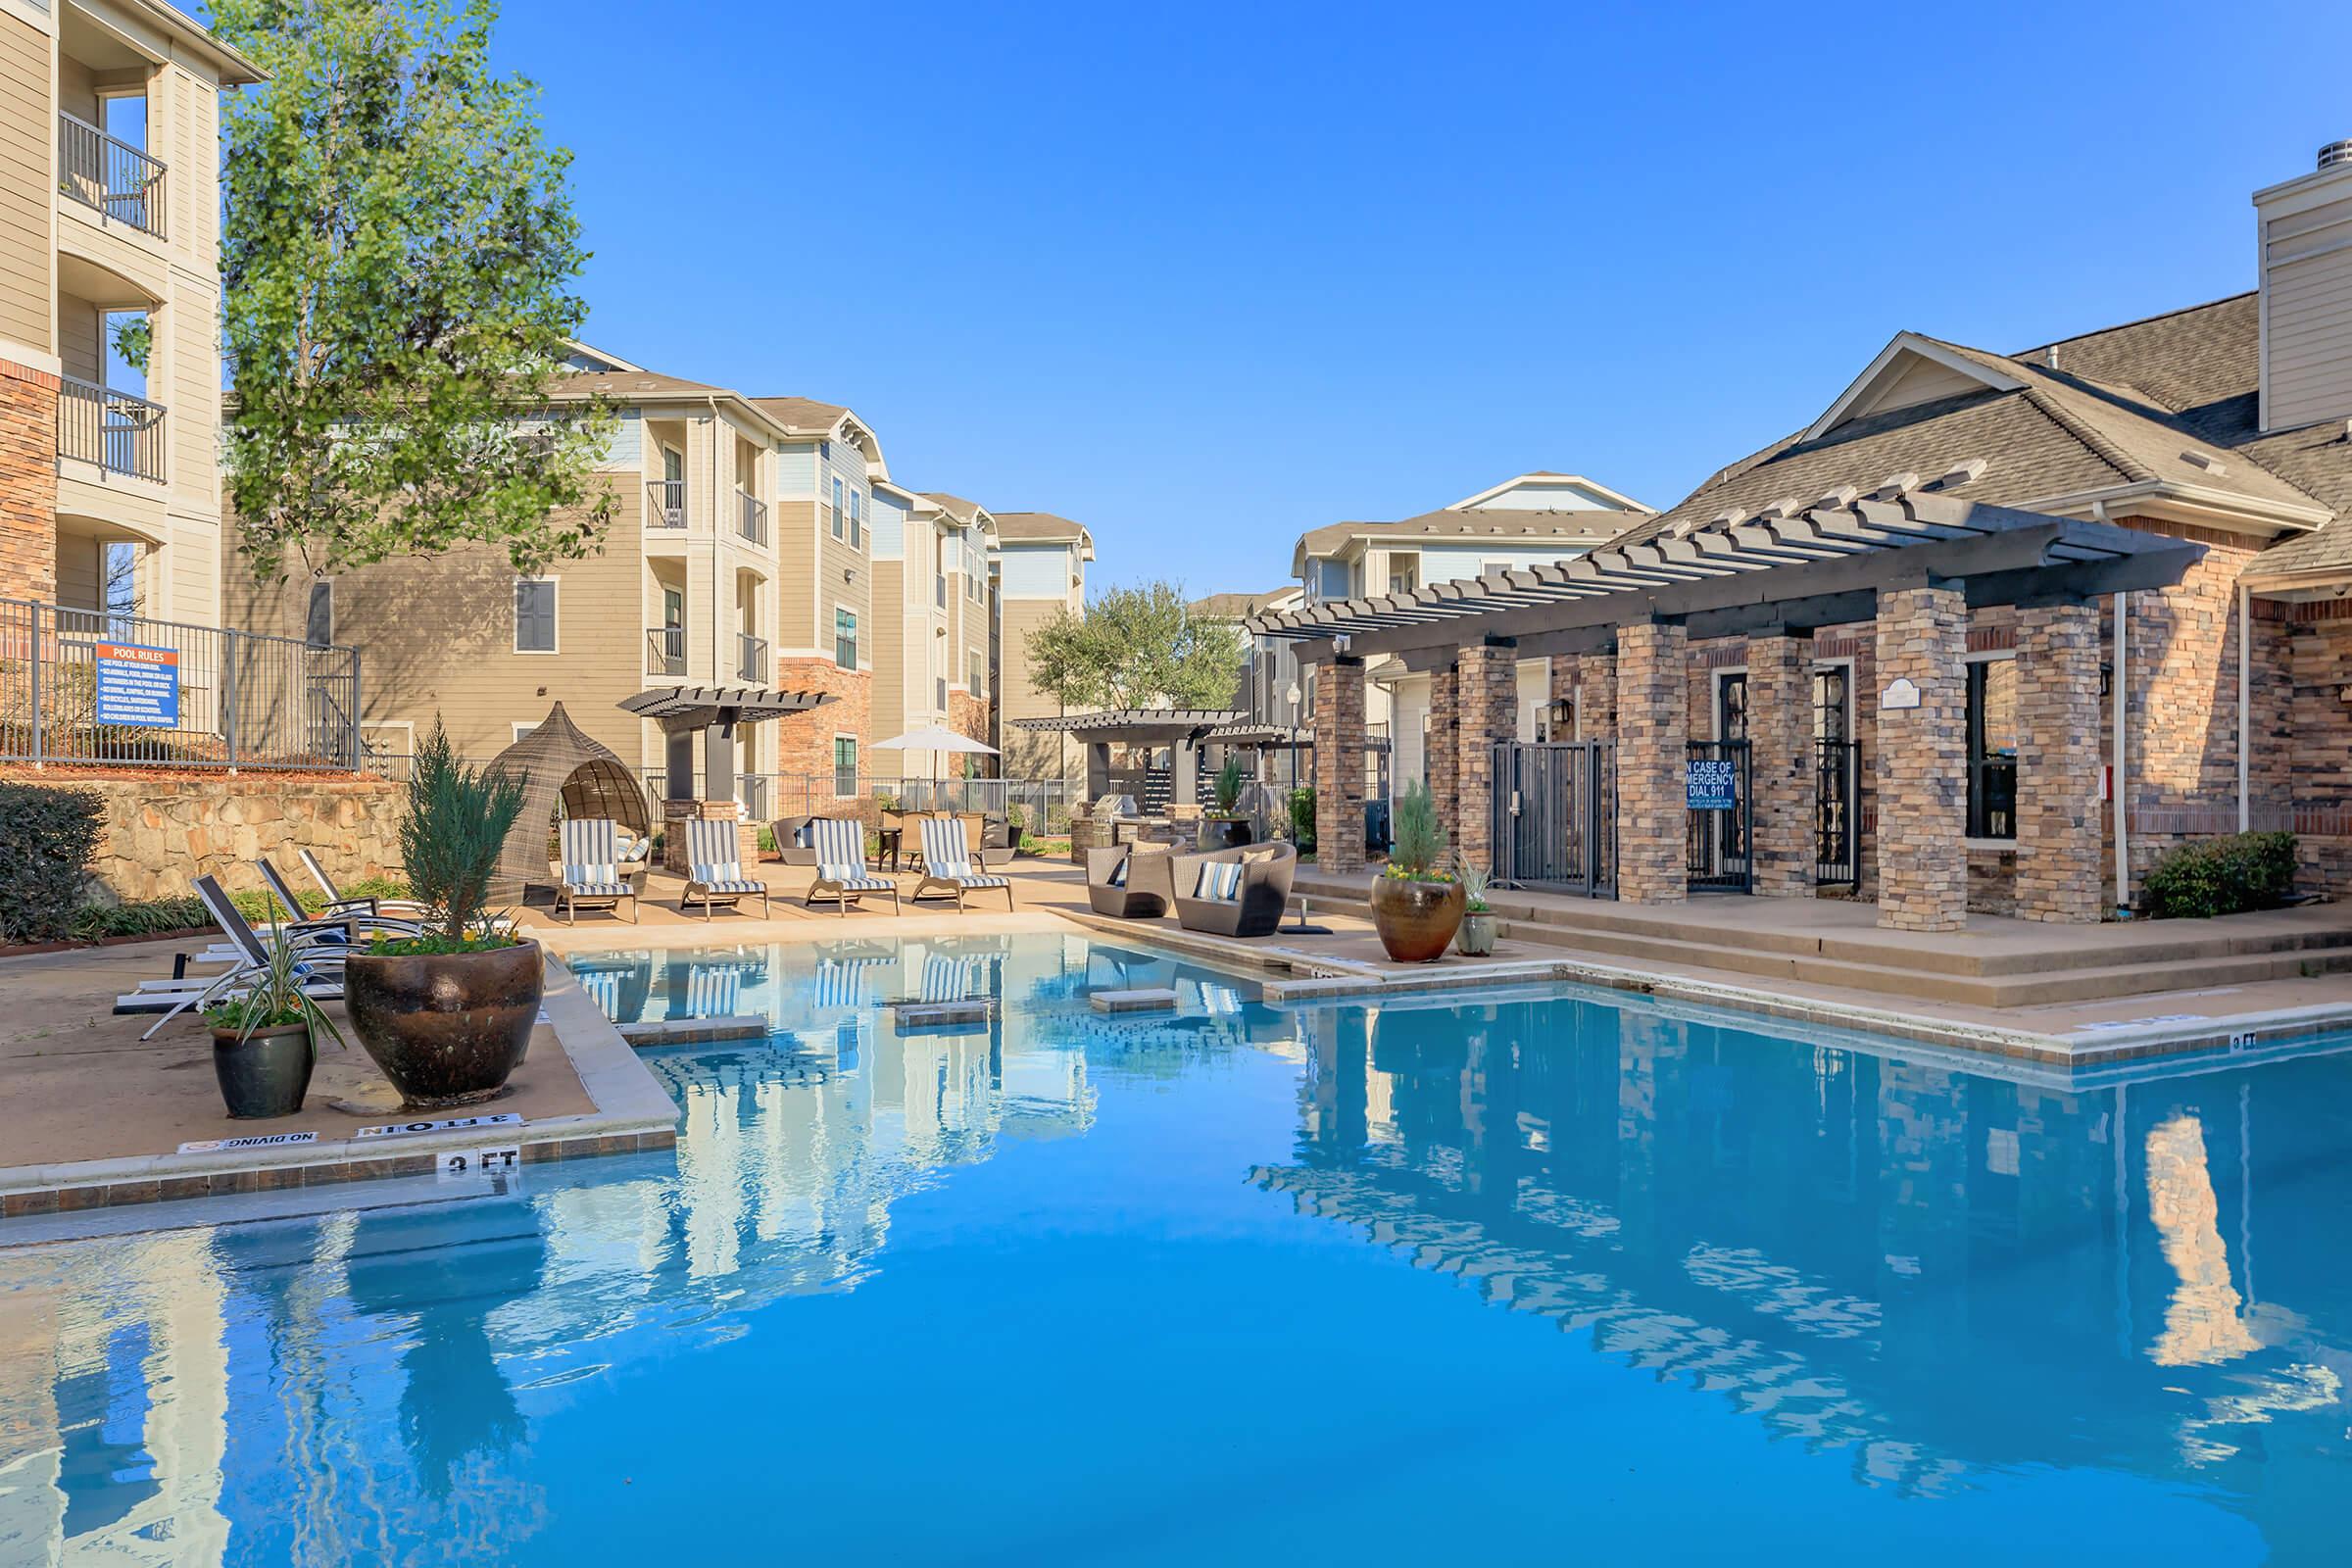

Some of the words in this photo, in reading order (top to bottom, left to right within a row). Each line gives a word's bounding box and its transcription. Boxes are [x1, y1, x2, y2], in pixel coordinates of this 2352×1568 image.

[113, 648, 137, 660] POOL
[138, 650, 165, 662] RULES
[1693, 761, 1717, 773] CASE
[1719, 761, 1732, 774] OF
[1686, 773, 1735, 785] MERGENCY
[1690, 785, 1709, 797] DIAL
[1710, 785, 1725, 797] 911
[442, 1118, 478, 1128] FT
[228, 1135, 287, 1148] DIVING
[290, 1133, 314, 1142] NO
[481, 1150, 517, 1169] FT
